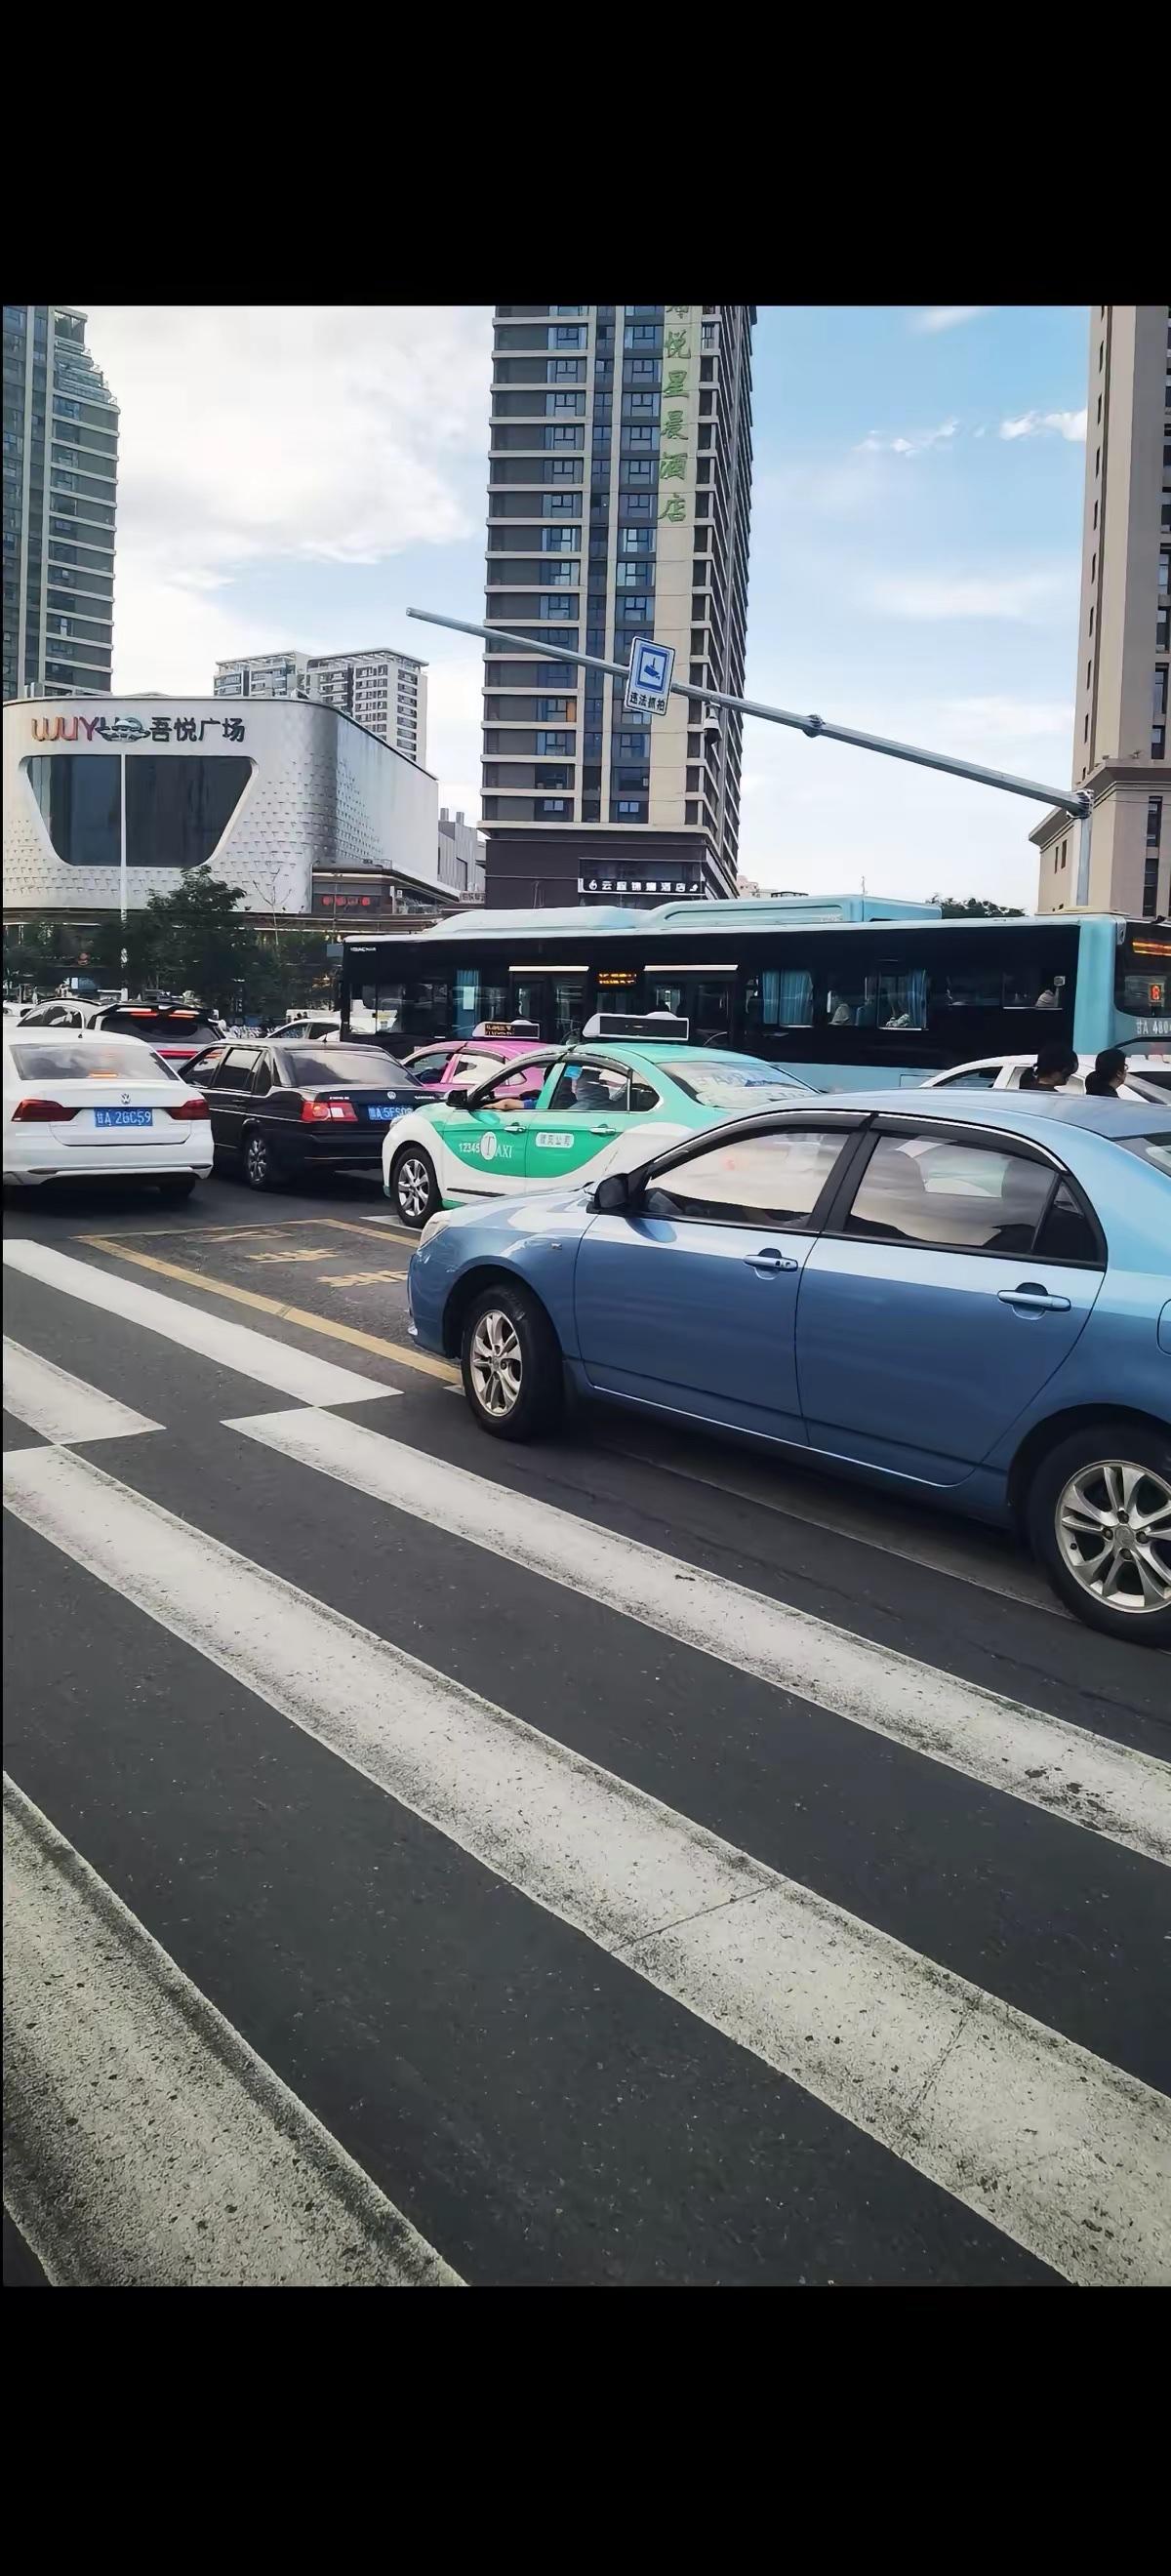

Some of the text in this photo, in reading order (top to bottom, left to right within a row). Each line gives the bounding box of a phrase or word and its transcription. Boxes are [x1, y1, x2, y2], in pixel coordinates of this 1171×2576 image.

[149, 717, 246, 743] 吾悦广场
[1152, 1020, 1171, 1034] 480
[97, 1111, 111, 1125] 甘A
[459, 1136, 512, 1159] 12345 TAXI
